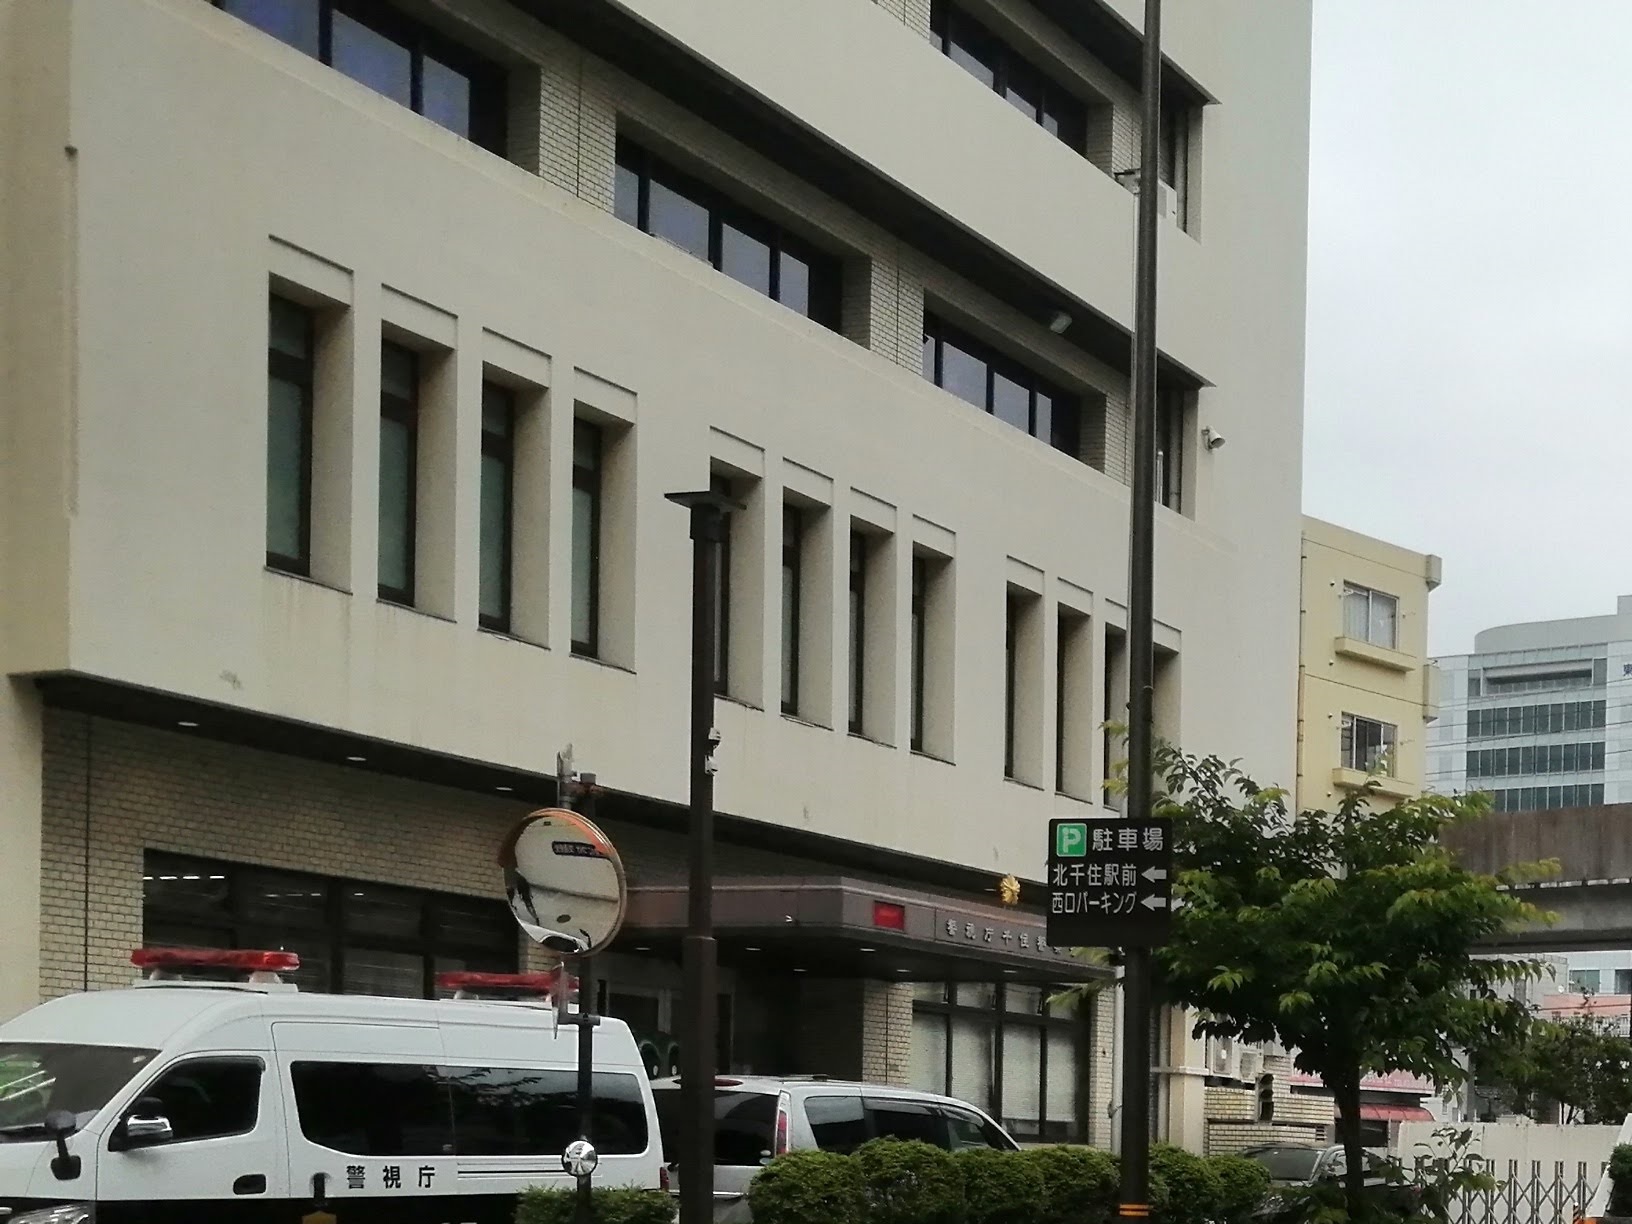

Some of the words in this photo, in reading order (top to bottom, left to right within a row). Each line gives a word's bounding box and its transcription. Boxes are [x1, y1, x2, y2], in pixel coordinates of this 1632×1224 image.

[1092, 828, 1164, 852] 駐車場
[1052, 863, 1137, 887] 北千住駅前
[1052, 891, 1137, 914] 西口パーキング
[346, 1165, 435, 1189] 警視庁
